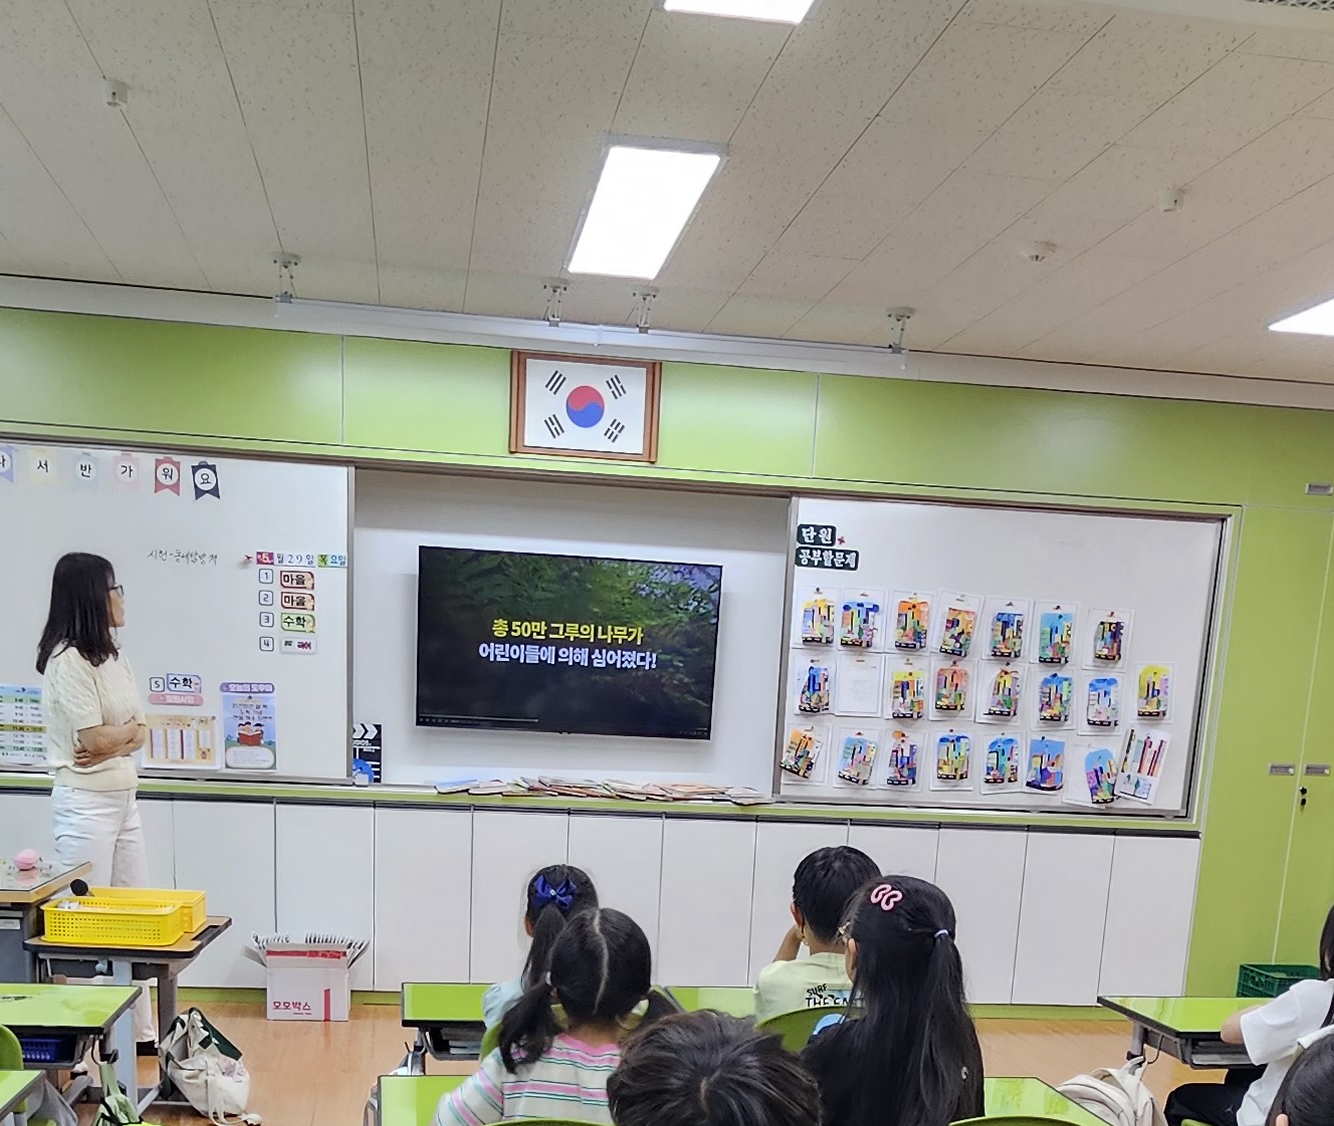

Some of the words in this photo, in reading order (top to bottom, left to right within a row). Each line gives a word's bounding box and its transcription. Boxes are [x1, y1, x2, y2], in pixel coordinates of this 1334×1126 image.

[801, 526, 835, 544] 단원
[282, 573, 307, 586] 마을
[283, 595, 307, 607] 마을
[282, 615, 307, 628] 수학
[491, 618, 509, 638] 총
[511, 620, 548, 640] 50만
[549, 622, 595, 642] 그루의
[596, 625, 644, 645] 나무가
[478, 642, 555, 665] 어린이들에
[557, 647, 588, 667] 의해
[590, 648, 657, 670] 심어졌다!
[169, 677, 193, 688] 수학
[806, 983, 828, 997] SURF
